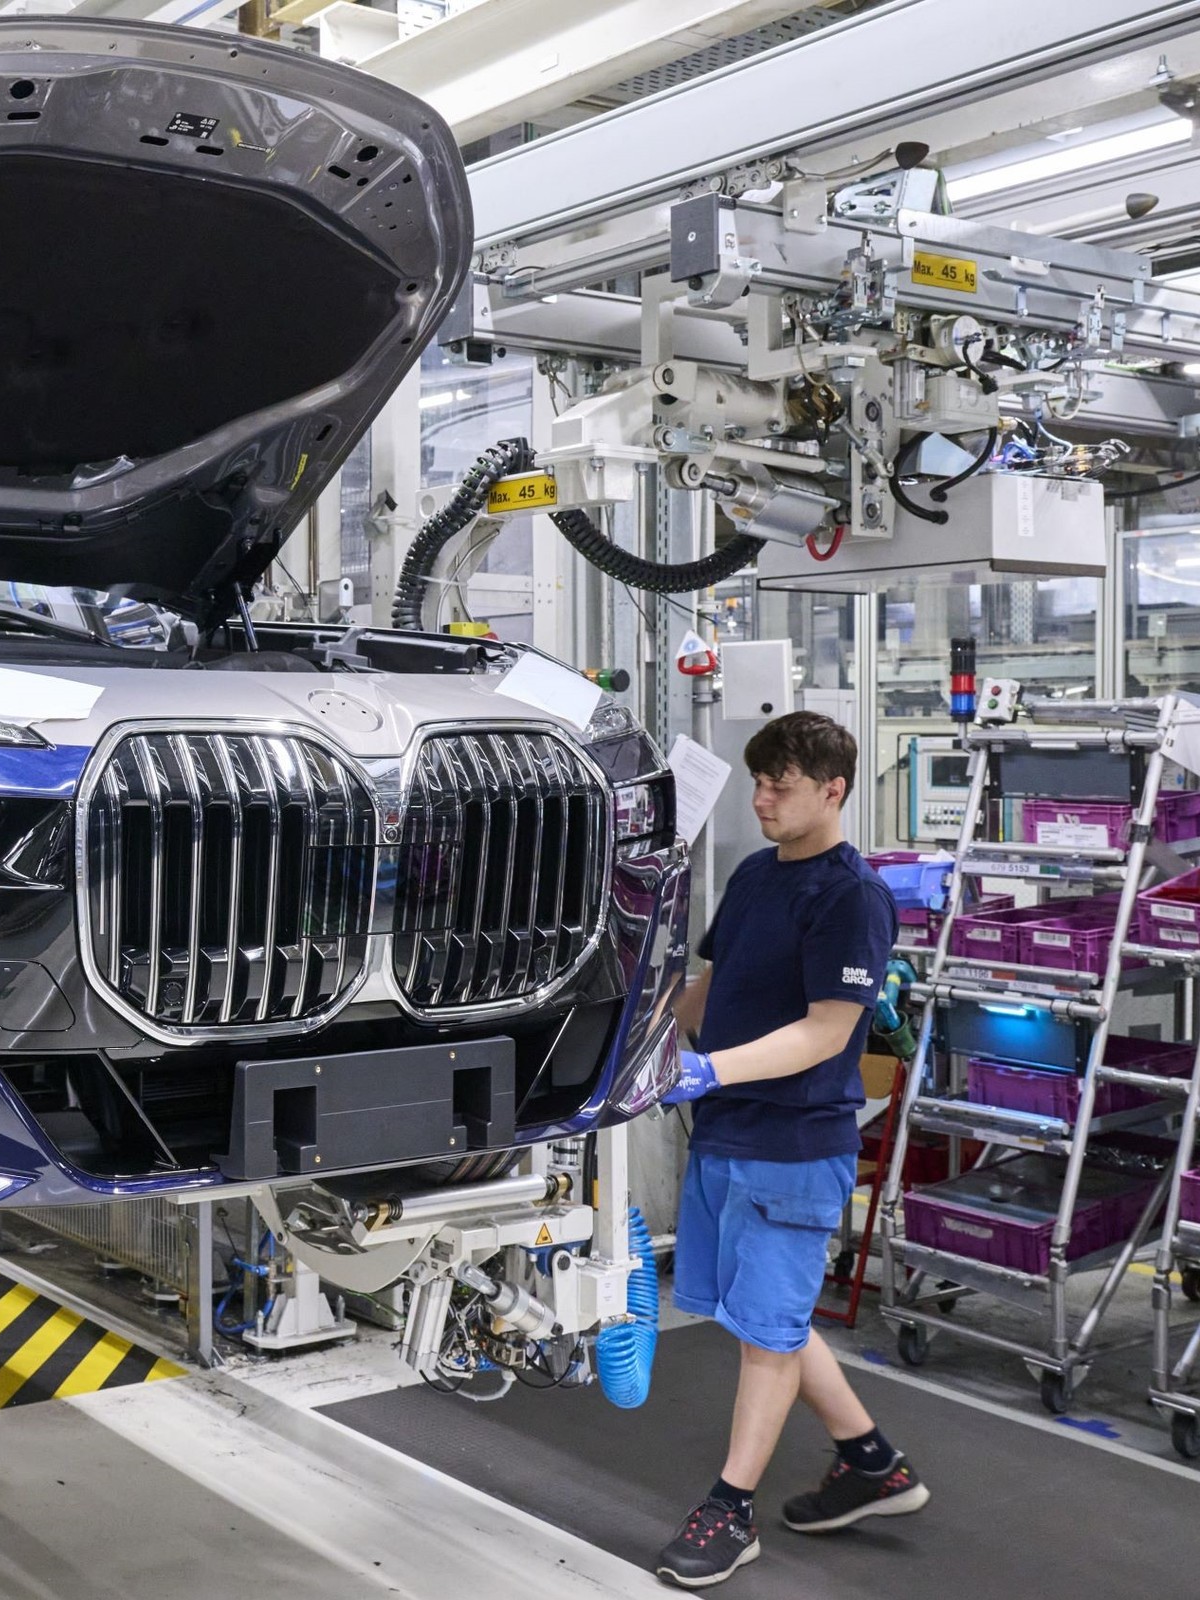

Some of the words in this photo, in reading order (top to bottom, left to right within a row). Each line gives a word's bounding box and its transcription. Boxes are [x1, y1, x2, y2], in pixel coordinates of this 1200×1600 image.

[913, 259, 934, 276] Max.
[941, 264, 957, 280] 45
[964, 268, 975, 287] kg
[489, 490, 511, 505] Max.
[518, 484, 536, 499] 45
[543, 482, 556, 499] kg
[1008, 864, 1030, 874] 5153
[843, 967, 868, 977] BMW
[842, 975, 874, 987] GROUP
